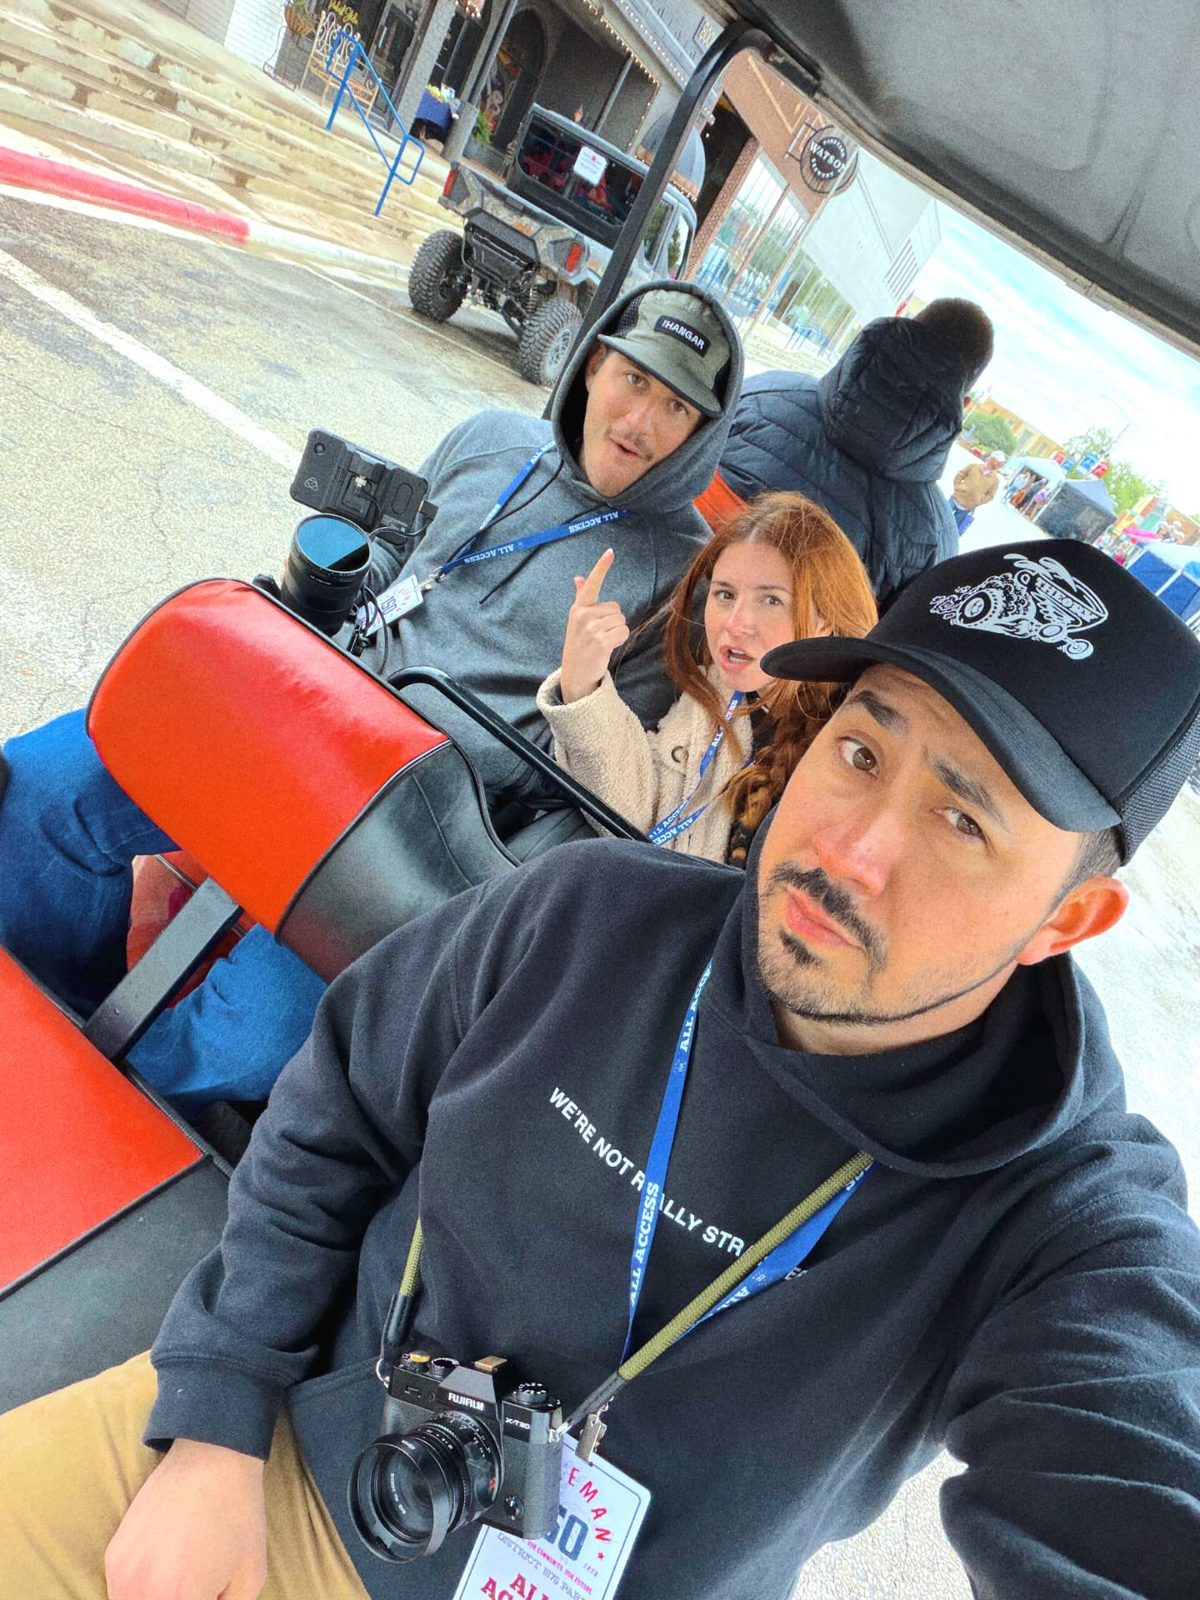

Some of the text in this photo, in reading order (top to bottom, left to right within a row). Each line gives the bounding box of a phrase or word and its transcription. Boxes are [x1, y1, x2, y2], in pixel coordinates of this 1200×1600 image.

[568, 511, 619, 533] ALL ACCESS
[463, 543, 514, 564] ALL ACCESS
[680, 1016, 694, 1053] ALL
[549, 1087, 597, 1144] WE'RE
[592, 1137, 634, 1176] NOT
[631, 1169, 703, 1232] RLLY
[634, 1182, 660, 1264] ACCESS
[448, 1392, 484, 1411] FUJIFILM
[567, 1466, 613, 1544] EMAN
[509, 1572, 550, 1600] AL
